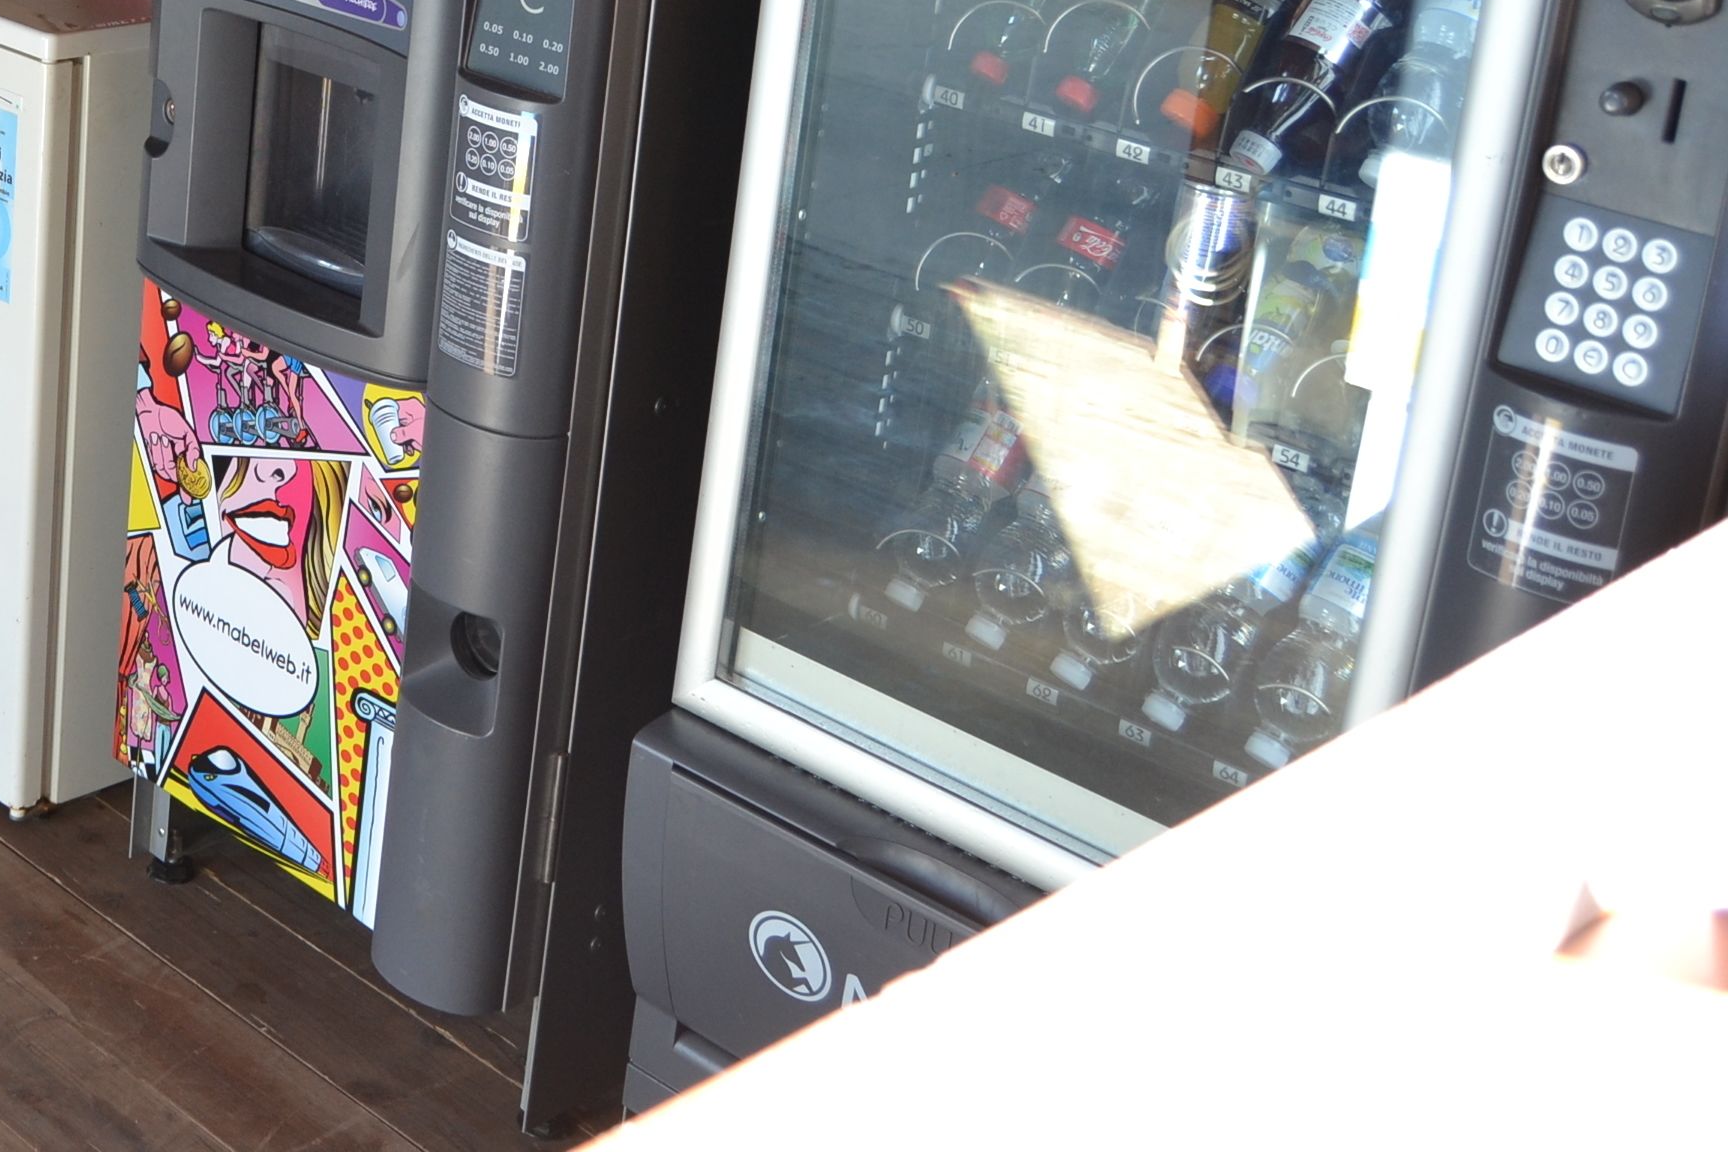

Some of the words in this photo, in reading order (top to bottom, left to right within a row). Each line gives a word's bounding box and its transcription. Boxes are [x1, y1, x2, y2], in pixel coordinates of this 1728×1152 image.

[483, 20, 503, 35] 0.05
[513, 29, 533, 44] 0.10
[542, 38, 563, 53] 0.20
[479, 42, 499, 57] 0.50
[509, 52, 529, 66] 1.00
[539, 61, 559, 75] 2.00
[940, 90, 958, 106] 40
[471, 107, 494, 121] ACCETTA
[1028, 116, 1047, 132] 41
[468, 131, 480, 142] 2.00
[484, 137, 497, 147] 1.00
[502, 143, 516, 153] 0.50
[1122, 144, 1143, 161] 42
[482, 159, 495, 170] 0.10
[500, 164, 514, 175] 0.05
[1222, 173, 1244, 189] 43
[471, 184, 490, 198] RENDE
[491, 189, 497, 199] IL
[1325, 201, 1347, 217] 44
[478, 213, 500, 228] display
[1578, 225, 1586, 243] 1
[1612, 237, 1627, 256] 2
[1653, 247, 1667, 266] 3
[1564, 263, 1579, 281] 4
[1603, 273, 1618, 292] 5
[1642, 285, 1656, 304] 6
[905, 319, 925, 335] 50
[1558, 299, 1570, 317] 7
[1593, 311, 1606, 330] 8
[1633, 322, 1648, 340] 9
[1545, 336, 1559, 355] 0
[1279, 449, 1301, 466] 54
[1568, 439, 1615, 461] MONETE
[1577, 478, 1601, 492] 0.50
[1571, 507, 1595, 522] 0.05
[1554, 540, 1565, 552] IL
[1567, 543, 1603, 562] RESTO
[1526, 568, 1565, 591] display
[178, 592, 312, 685] www.mabelweb.it
[947, 648, 964, 662] 61
[1032, 684, 1052, 701] 62
[1125, 725, 1144, 742] 63
[1219, 767, 1240, 783] 64
